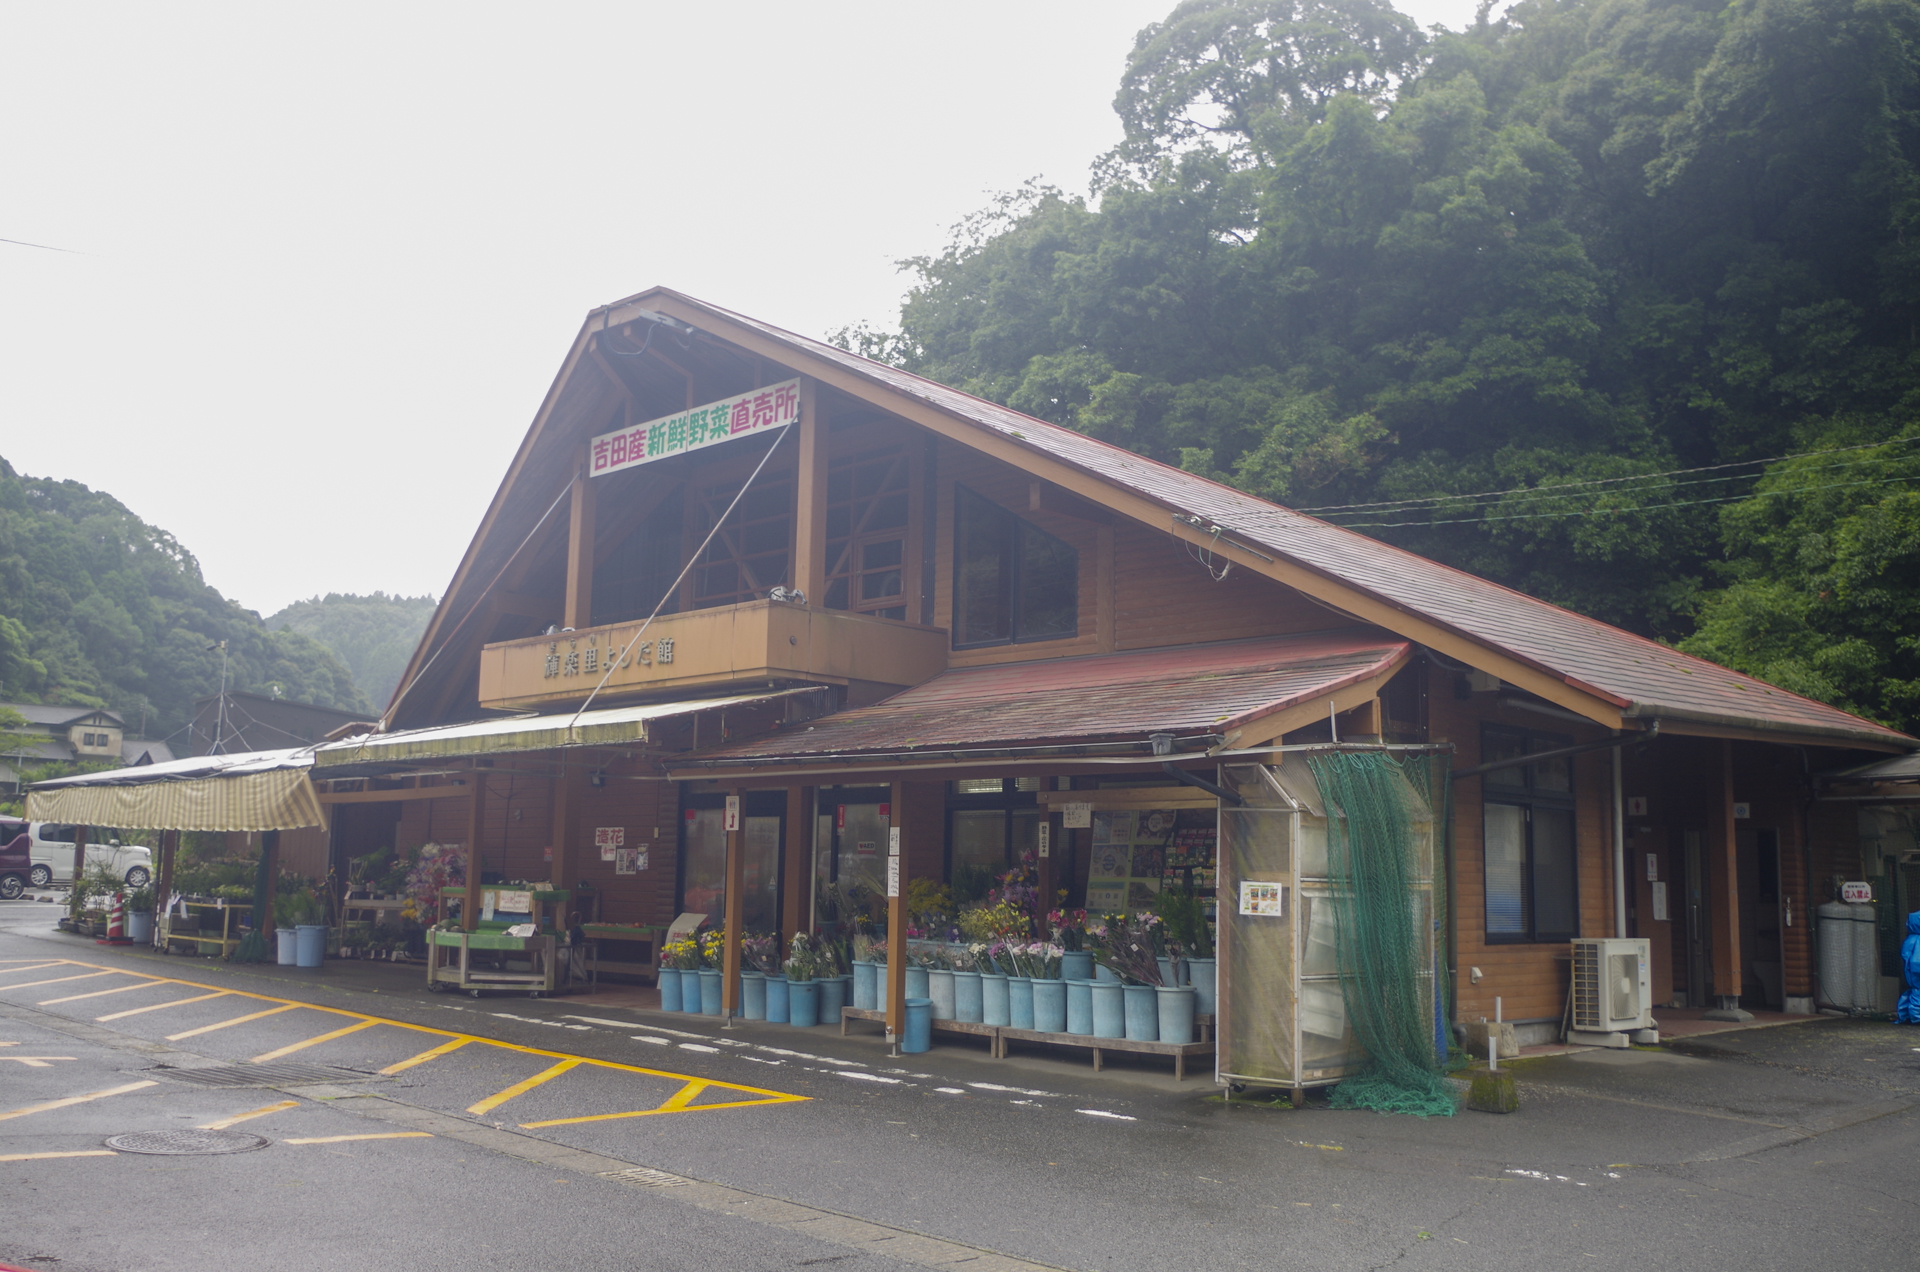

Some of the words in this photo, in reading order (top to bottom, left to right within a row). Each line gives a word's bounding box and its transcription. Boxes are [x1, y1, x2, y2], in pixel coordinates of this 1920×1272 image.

[593, 383, 797, 471] 吉田産新鮮野菜直売所
[597, 828, 623, 844] 造花
[1844, 889, 1870, 899] 立入禁止
